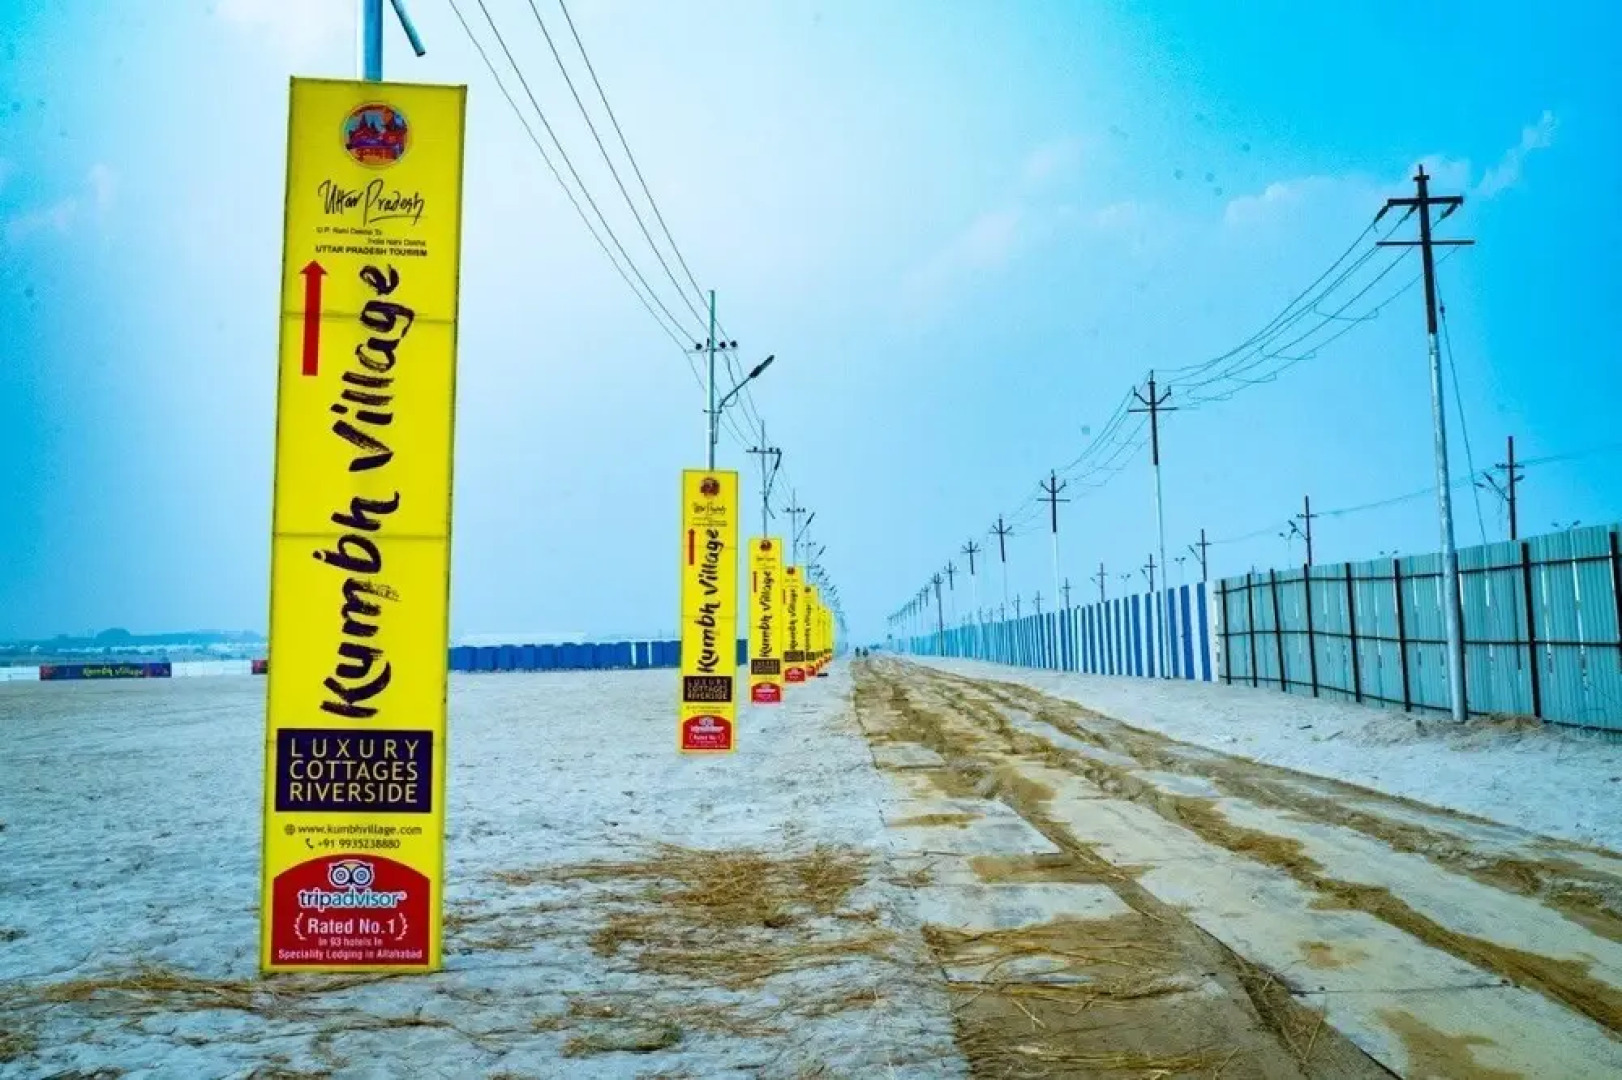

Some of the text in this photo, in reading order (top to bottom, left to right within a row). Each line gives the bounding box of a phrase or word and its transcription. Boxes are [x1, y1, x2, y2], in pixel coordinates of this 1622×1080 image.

[318, 177, 426, 227] Uttar Pradesh
[315, 244, 428, 257] UTTAR PRADESH TOURISM
[312, 264, 415, 719] Kumbh Village
[698, 529, 725, 596] Village
[694, 600, 721, 673] Kumbh
[290, 737, 419, 760] LUXURY
[289, 760, 418, 782] COTTAGES
[289, 782, 418, 804] RIVERSIDE
[298, 824, 423, 836] www.kumbhvillage.com
[318, 838, 336, 849] +91
[298, 888, 399, 911] tripadvisor
[307, 918, 353, 935] Rated
[343, 937, 372, 947] hotels
[325, 949, 363, 961] Lodging
